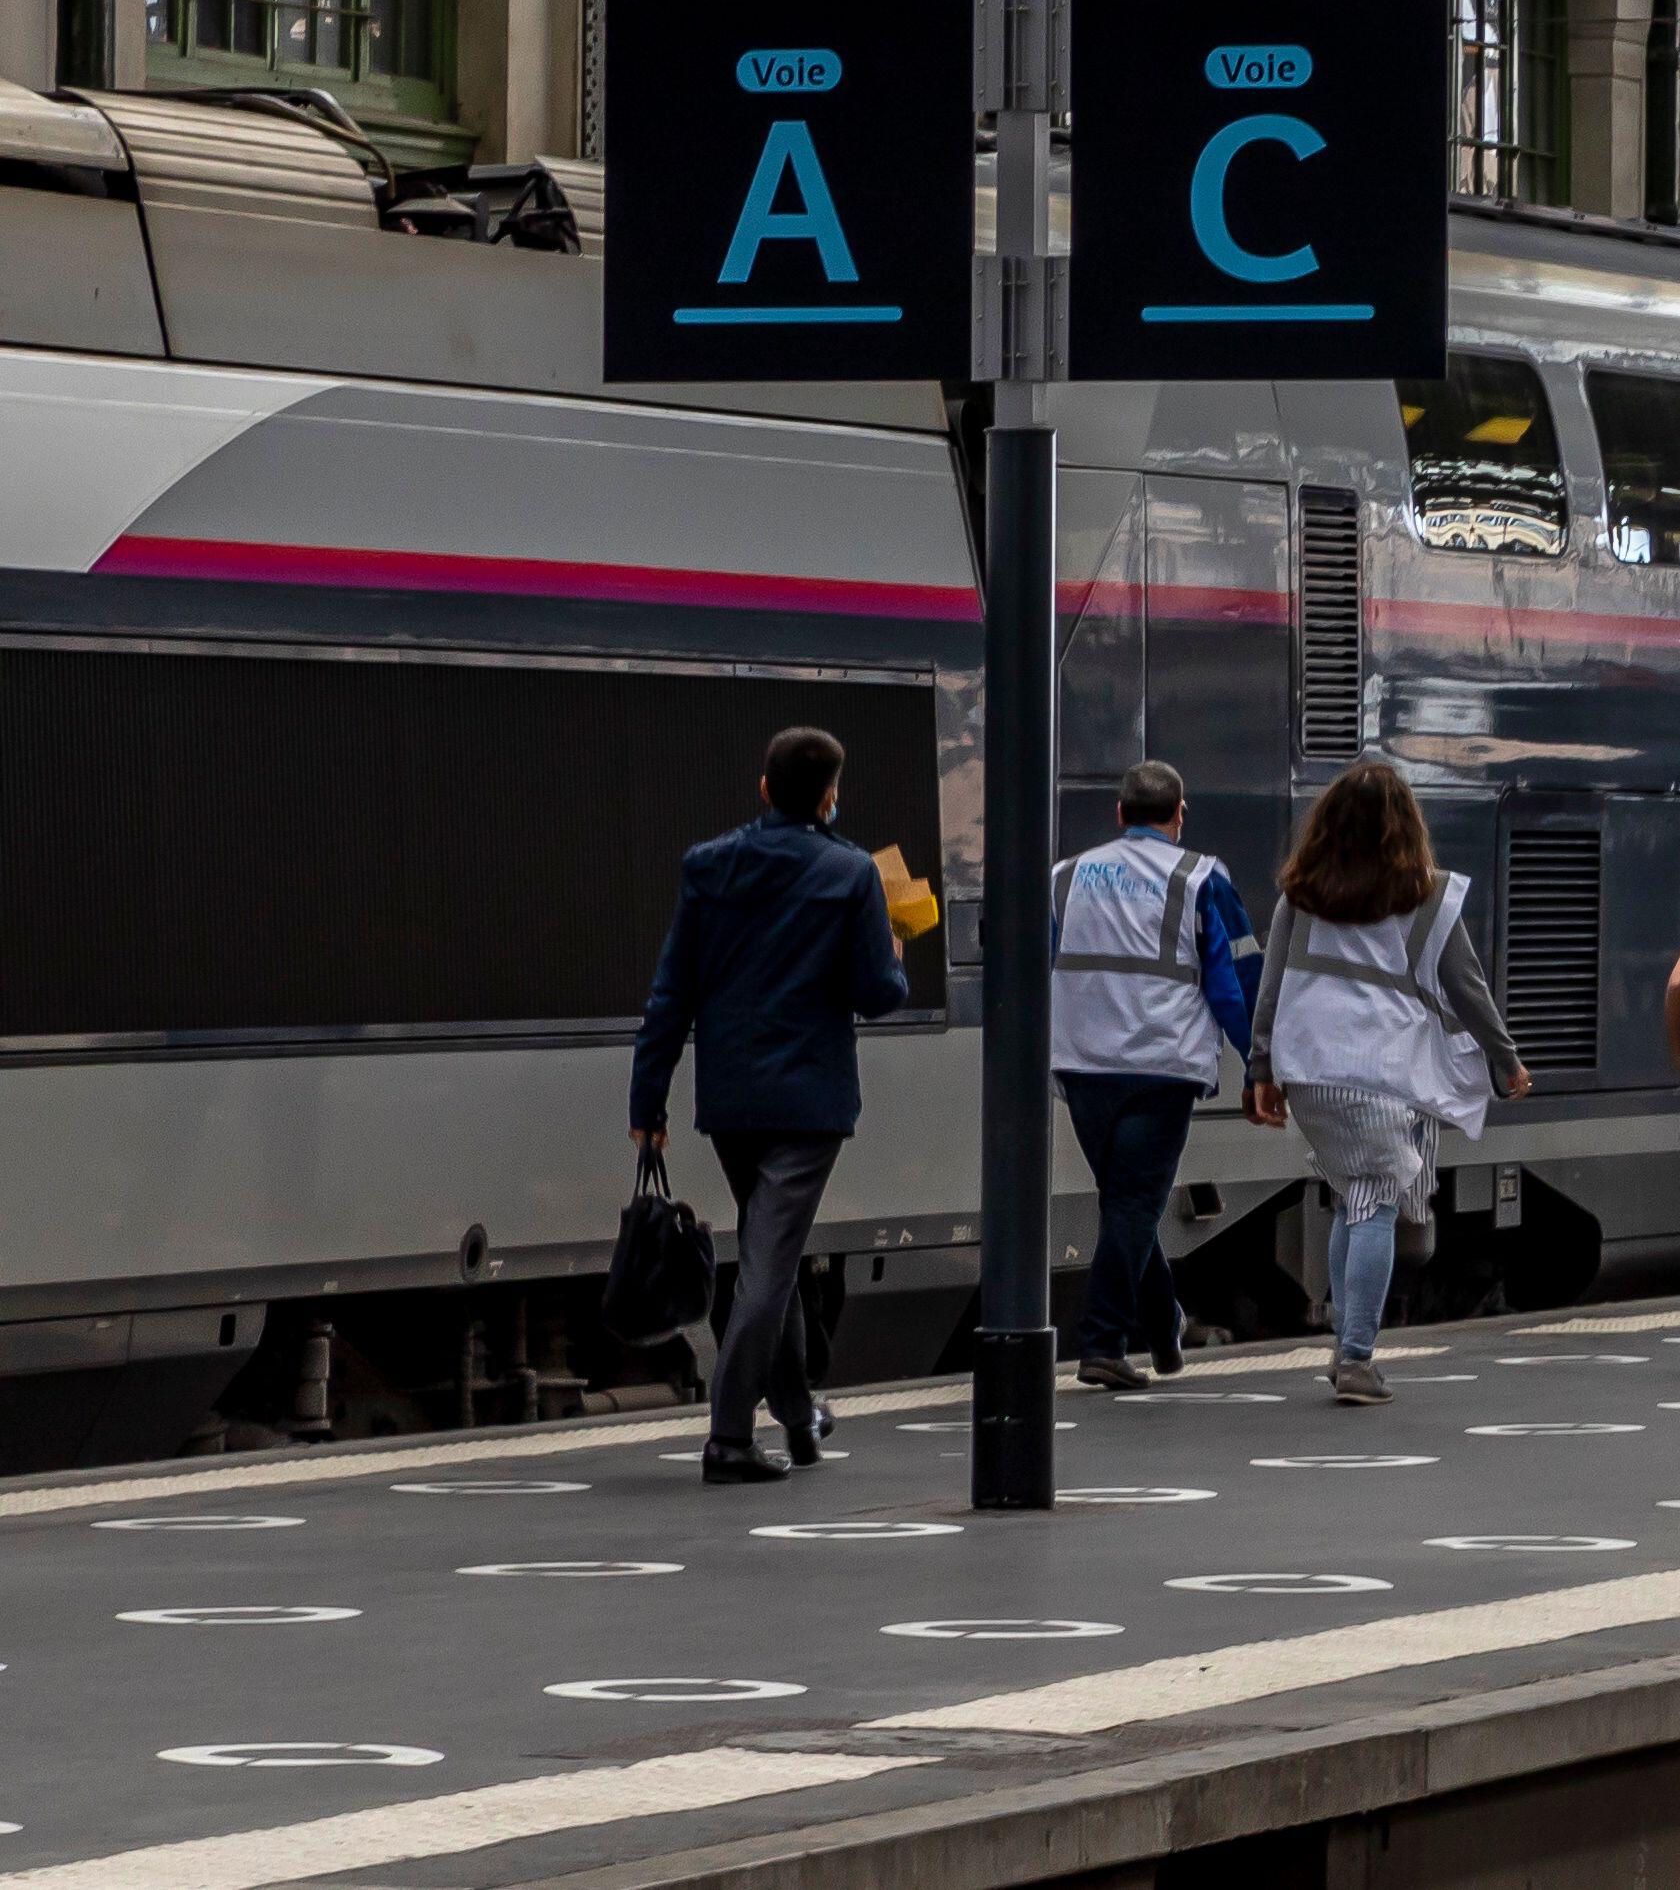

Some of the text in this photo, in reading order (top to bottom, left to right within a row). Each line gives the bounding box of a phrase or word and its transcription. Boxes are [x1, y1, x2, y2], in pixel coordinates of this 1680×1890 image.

[752, 57, 826, 90] Voie
[1220, 51, 1297, 84] Voie
[717, 120, 860, 284] A
[1190, 113, 1328, 284] C
[1077, 862, 1127, 879] SNCF
